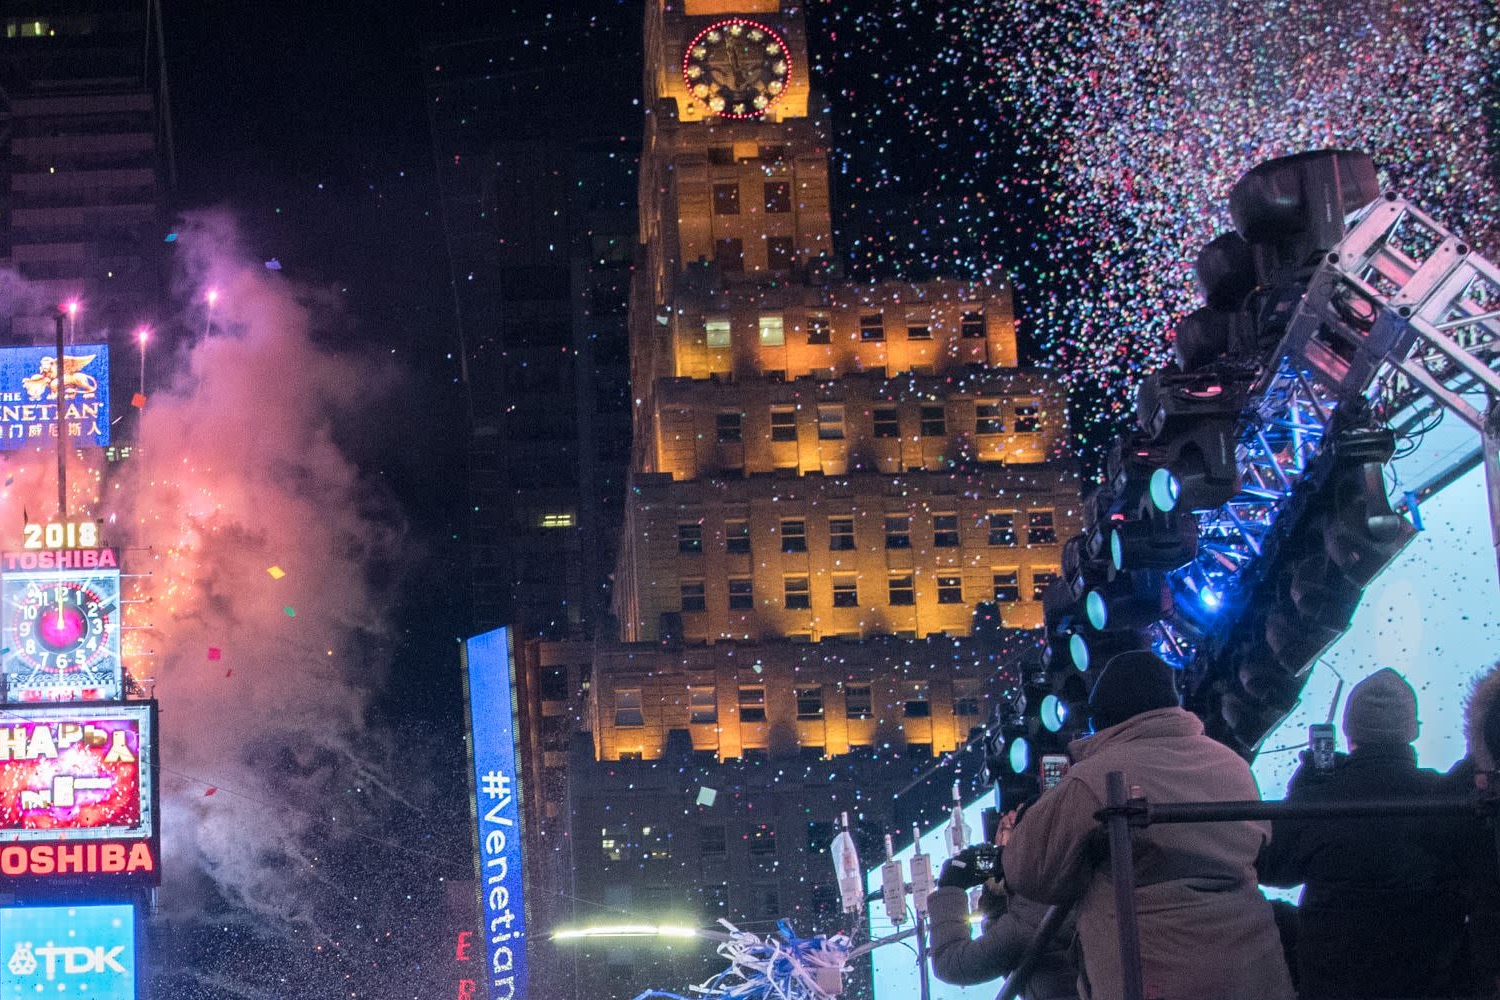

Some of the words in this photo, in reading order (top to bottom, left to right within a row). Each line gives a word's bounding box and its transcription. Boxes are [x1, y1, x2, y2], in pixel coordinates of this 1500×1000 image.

[23, 522, 97, 550] 2018
[3, 548, 117, 571] TOSHIBA
[35, 944, 127, 974] TDK
